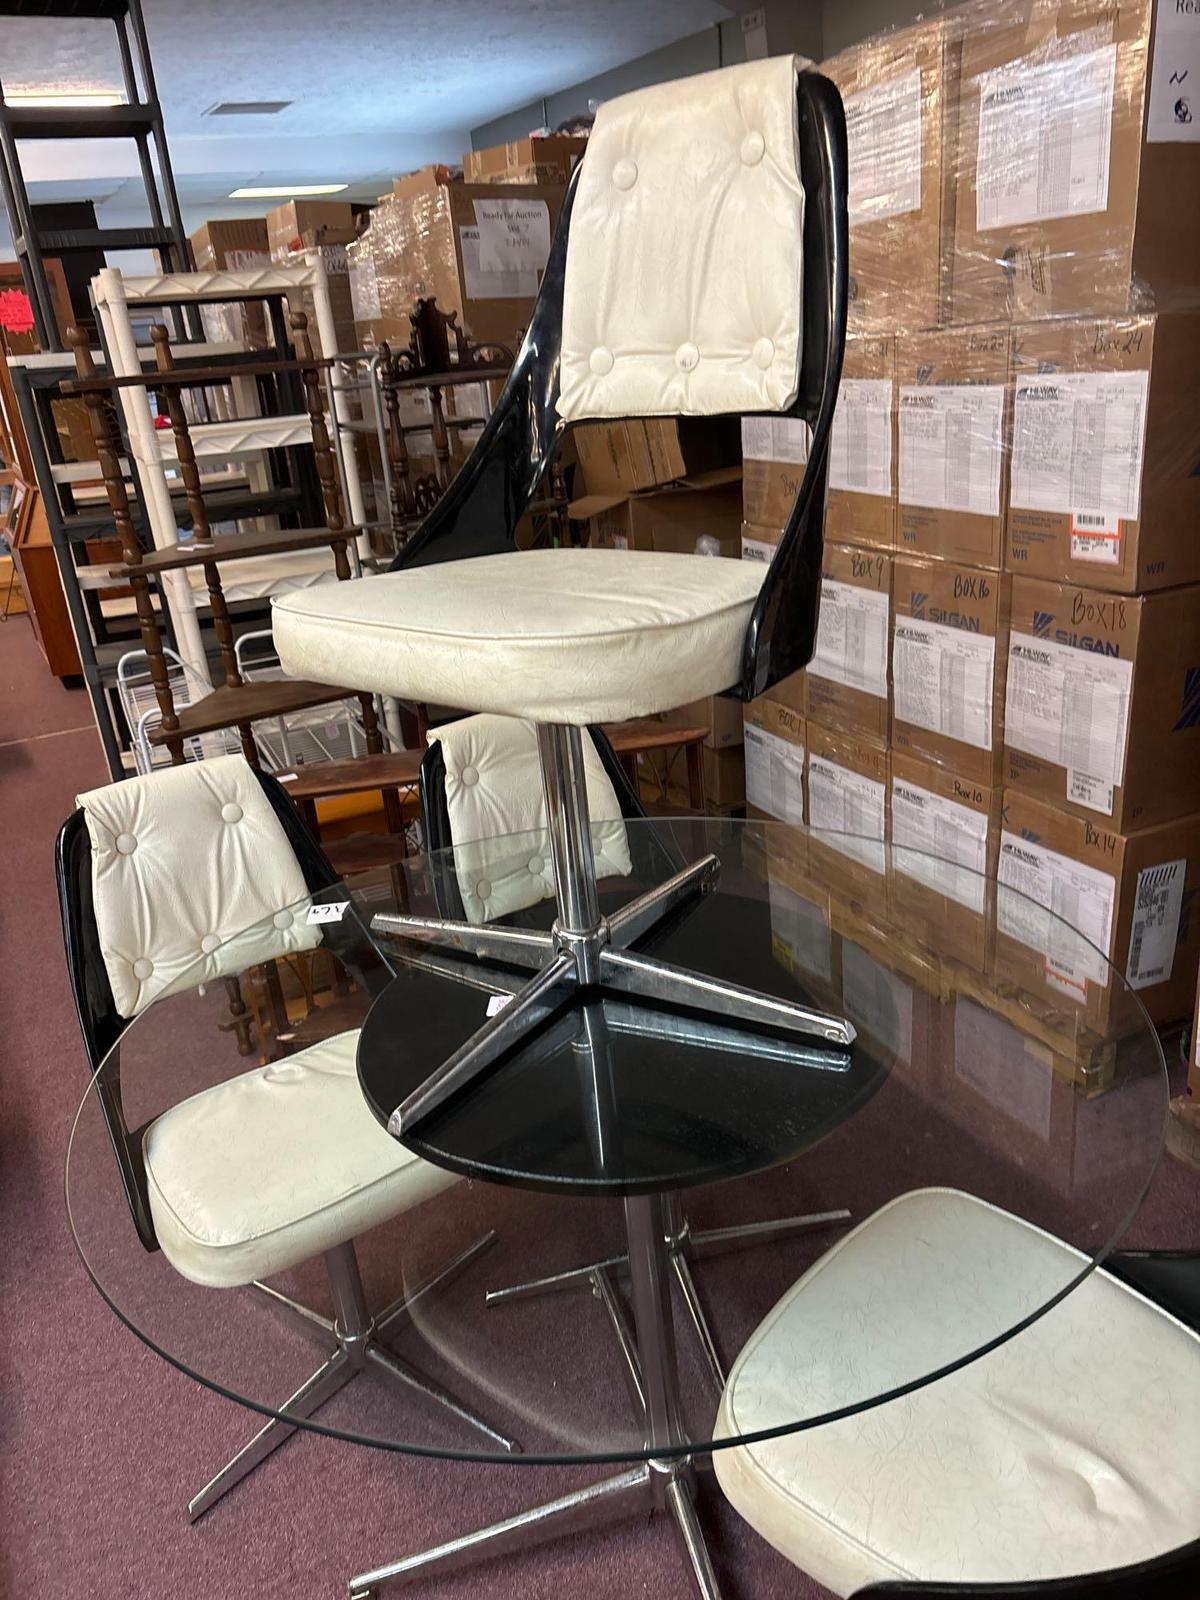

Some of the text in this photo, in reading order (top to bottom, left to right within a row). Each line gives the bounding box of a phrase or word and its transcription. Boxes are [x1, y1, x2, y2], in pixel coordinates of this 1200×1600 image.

[516, 211, 541, 219] Auction
[1122, 331, 1143, 354] 24
[1012, 548, 1027, 561] WR
[876, 557, 884, 588] 9
[972, 788, 983, 804] 10
[1103, 834, 1116, 857] 14
